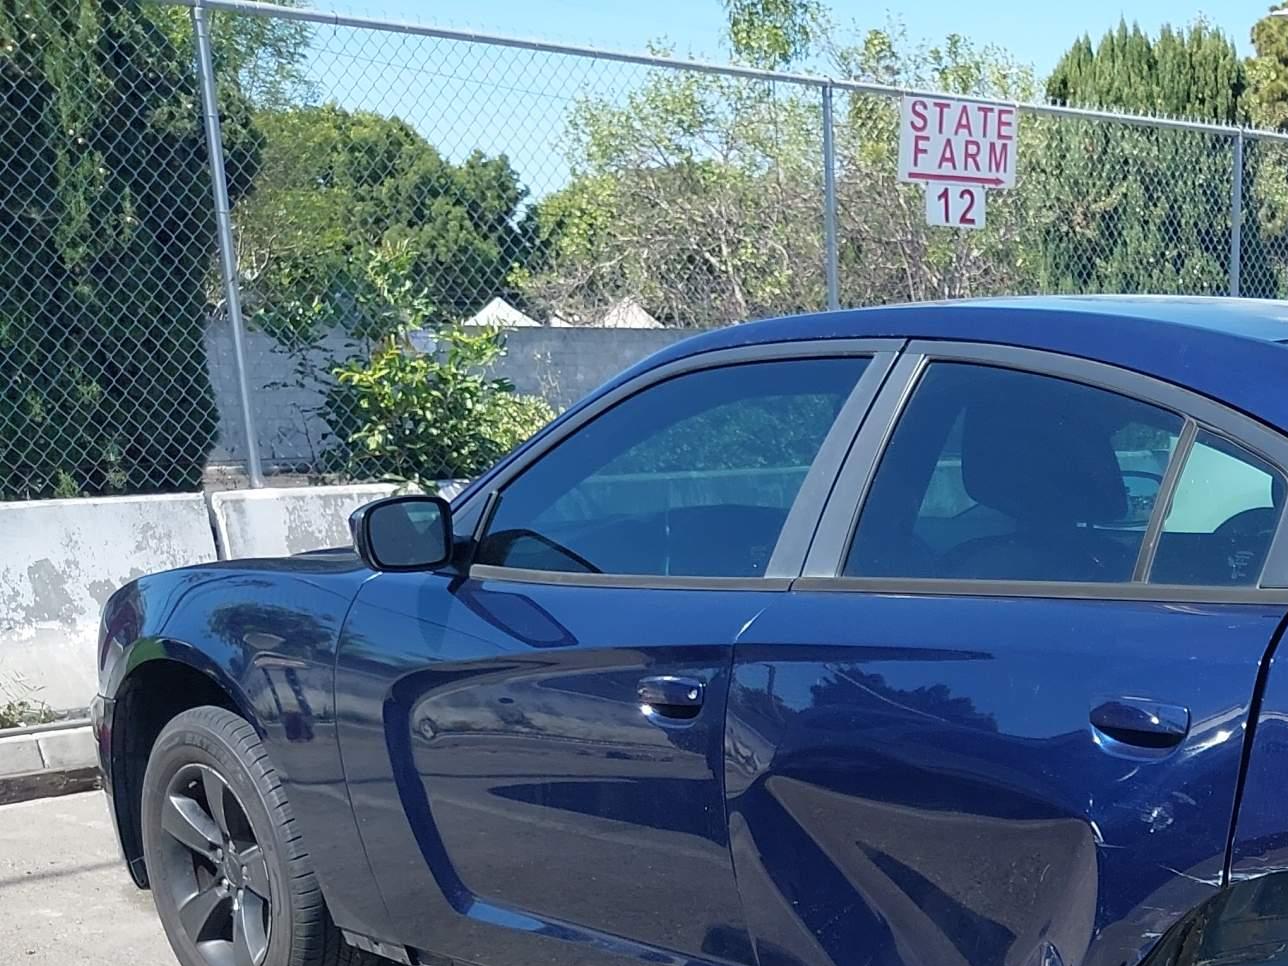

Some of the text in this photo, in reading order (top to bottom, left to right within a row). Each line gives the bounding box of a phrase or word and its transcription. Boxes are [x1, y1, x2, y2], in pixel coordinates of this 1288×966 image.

[910, 100, 1014, 140] STATE
[913, 135, 1008, 173] FARM
[937, 187, 976, 225] 12
